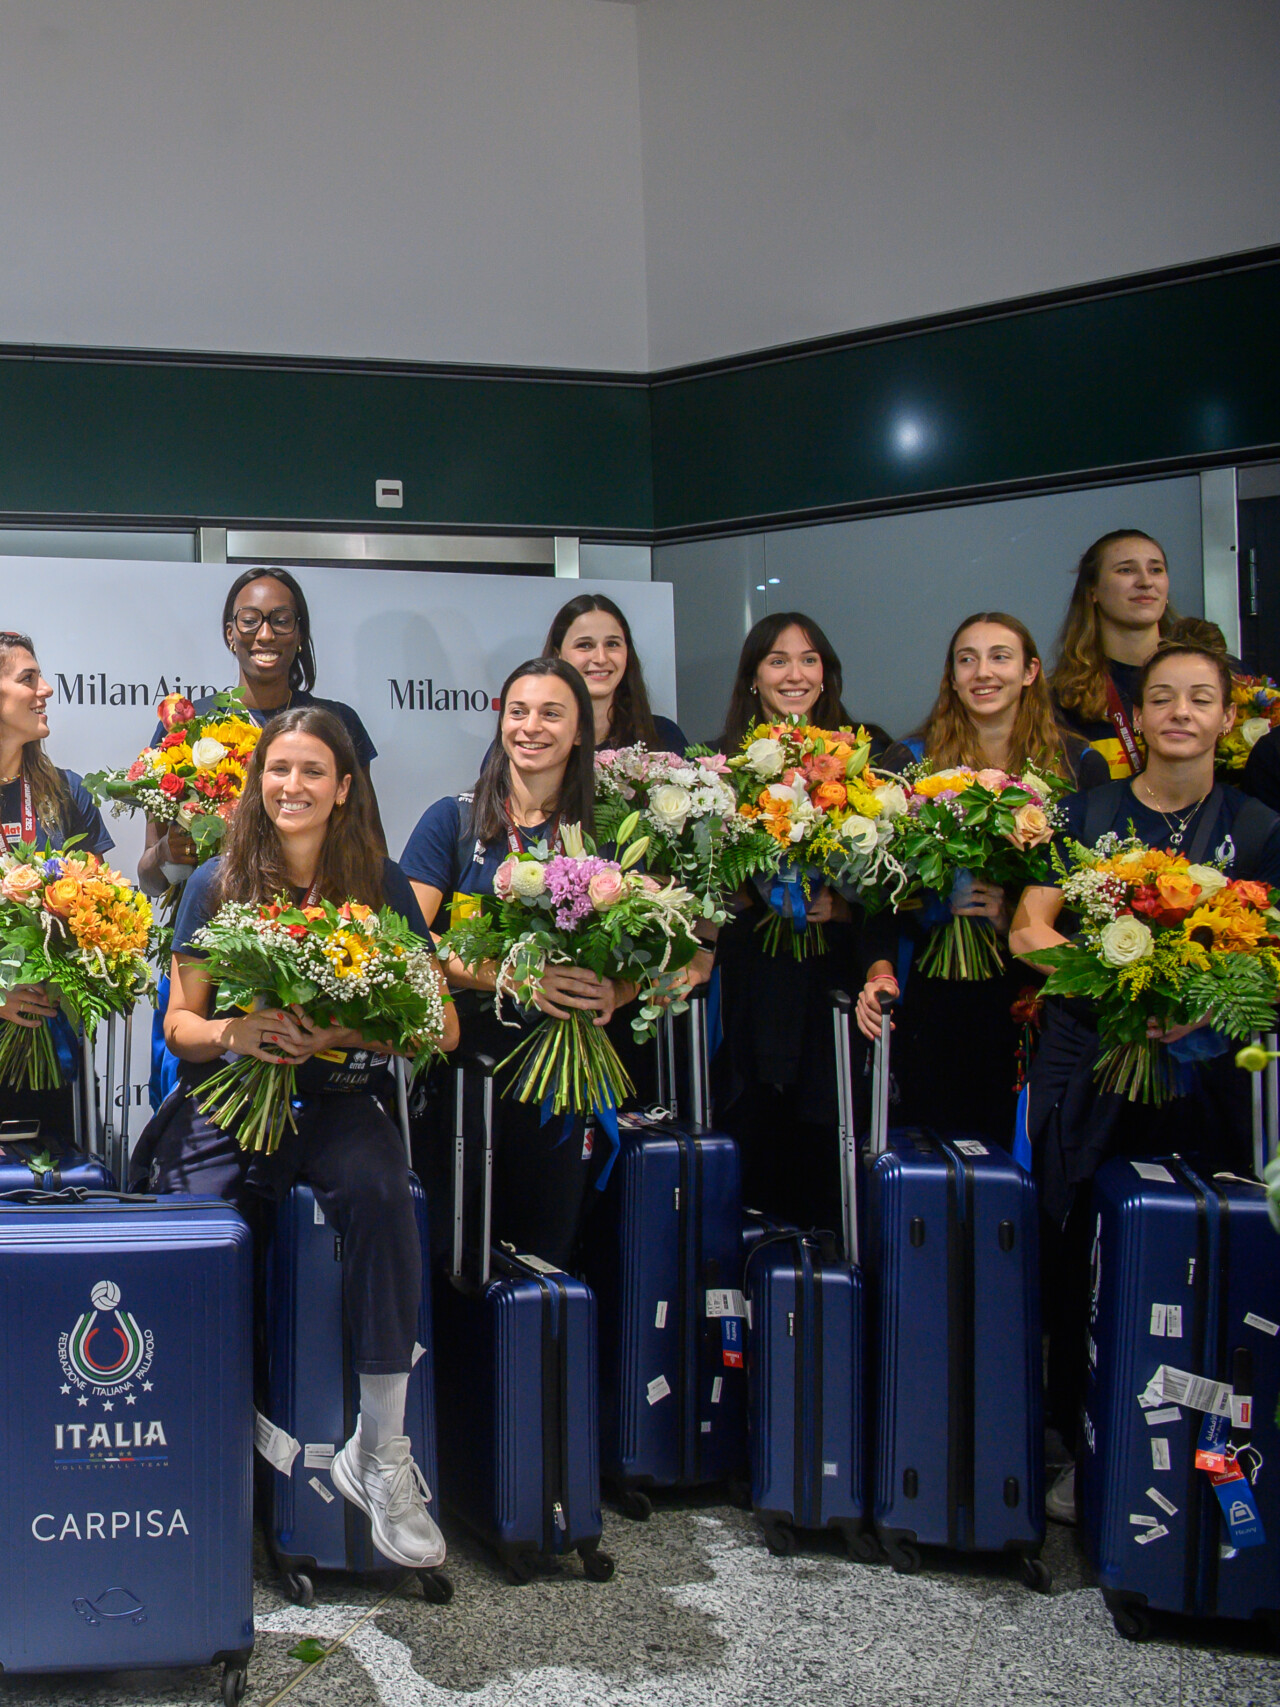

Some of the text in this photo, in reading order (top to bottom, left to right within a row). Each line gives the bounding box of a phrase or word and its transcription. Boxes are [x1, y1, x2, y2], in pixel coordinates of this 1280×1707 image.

[387, 679, 489, 711] Milano
[25, 817, 33, 831] 2025
[57, 1329, 155, 1396] FEDERAZIONE ITALIANA PALLAVOLO
[54, 1420, 168, 1450] ITALIA
[31, 1508, 190, 1542] CARPISA
